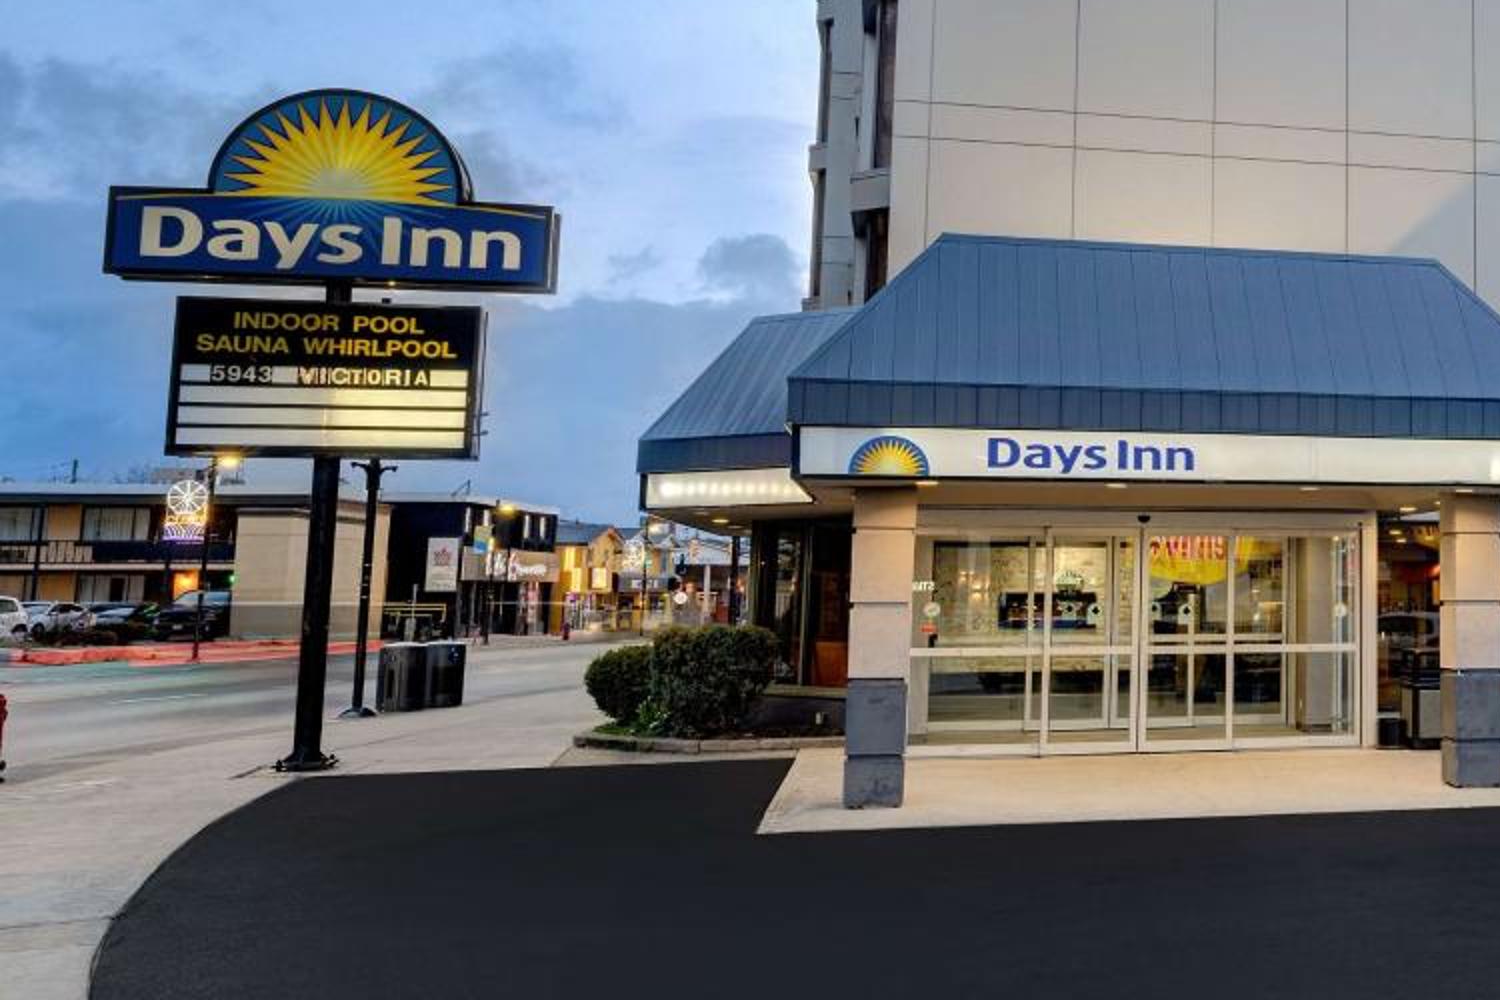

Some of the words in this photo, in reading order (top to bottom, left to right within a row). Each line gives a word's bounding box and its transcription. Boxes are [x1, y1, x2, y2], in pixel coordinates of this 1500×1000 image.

[138, 205, 363, 269] Days
[380, 216, 522, 271] Inn
[233, 311, 340, 331] INDOOR
[353, 315, 426, 334] POOL
[195, 333, 289, 354] SAUNA
[304, 338, 458, 359] WHIRLPOOL
[212, 365, 272, 383] 5943
[298, 367, 429, 387] VICTORIA
[987, 437, 1107, 473] Days
[1117, 439, 1195, 471] Inn
